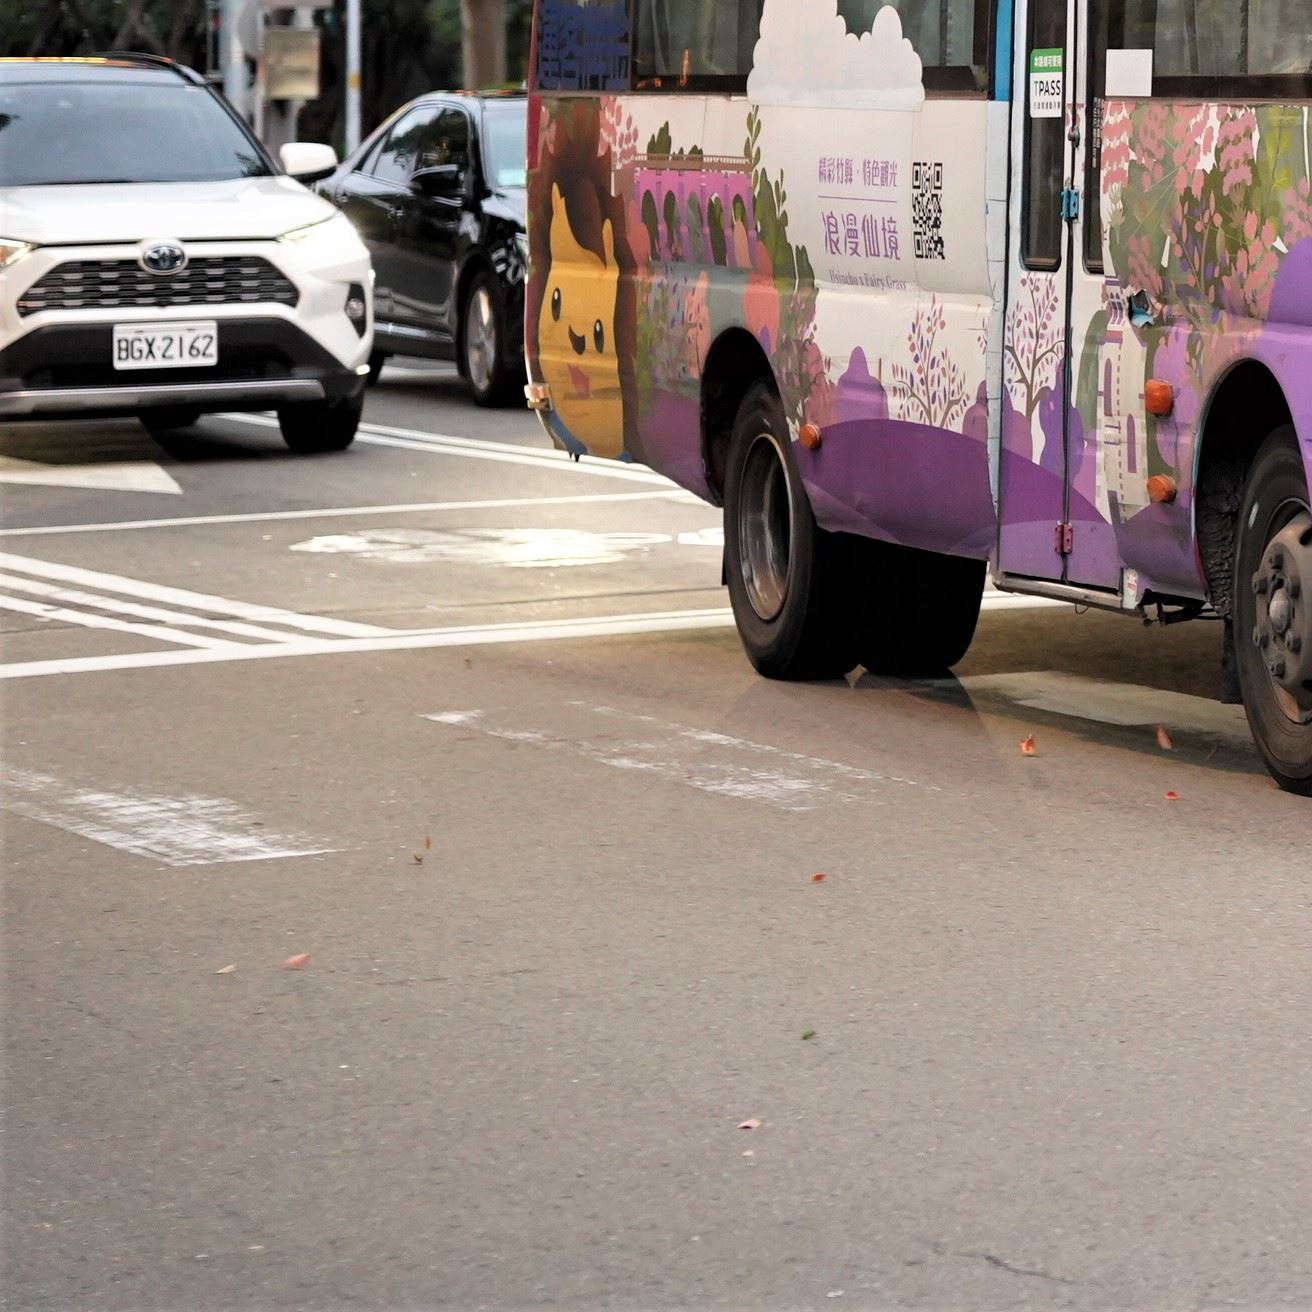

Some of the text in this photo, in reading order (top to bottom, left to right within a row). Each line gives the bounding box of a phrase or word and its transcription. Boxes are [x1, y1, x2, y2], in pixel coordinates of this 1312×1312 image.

[1034, 80, 1061, 96] TPASS
[822, 211, 901, 260] 浪漫仙境
[864, 273, 885, 291] Fairy
[886, 275, 907, 290] Grass
